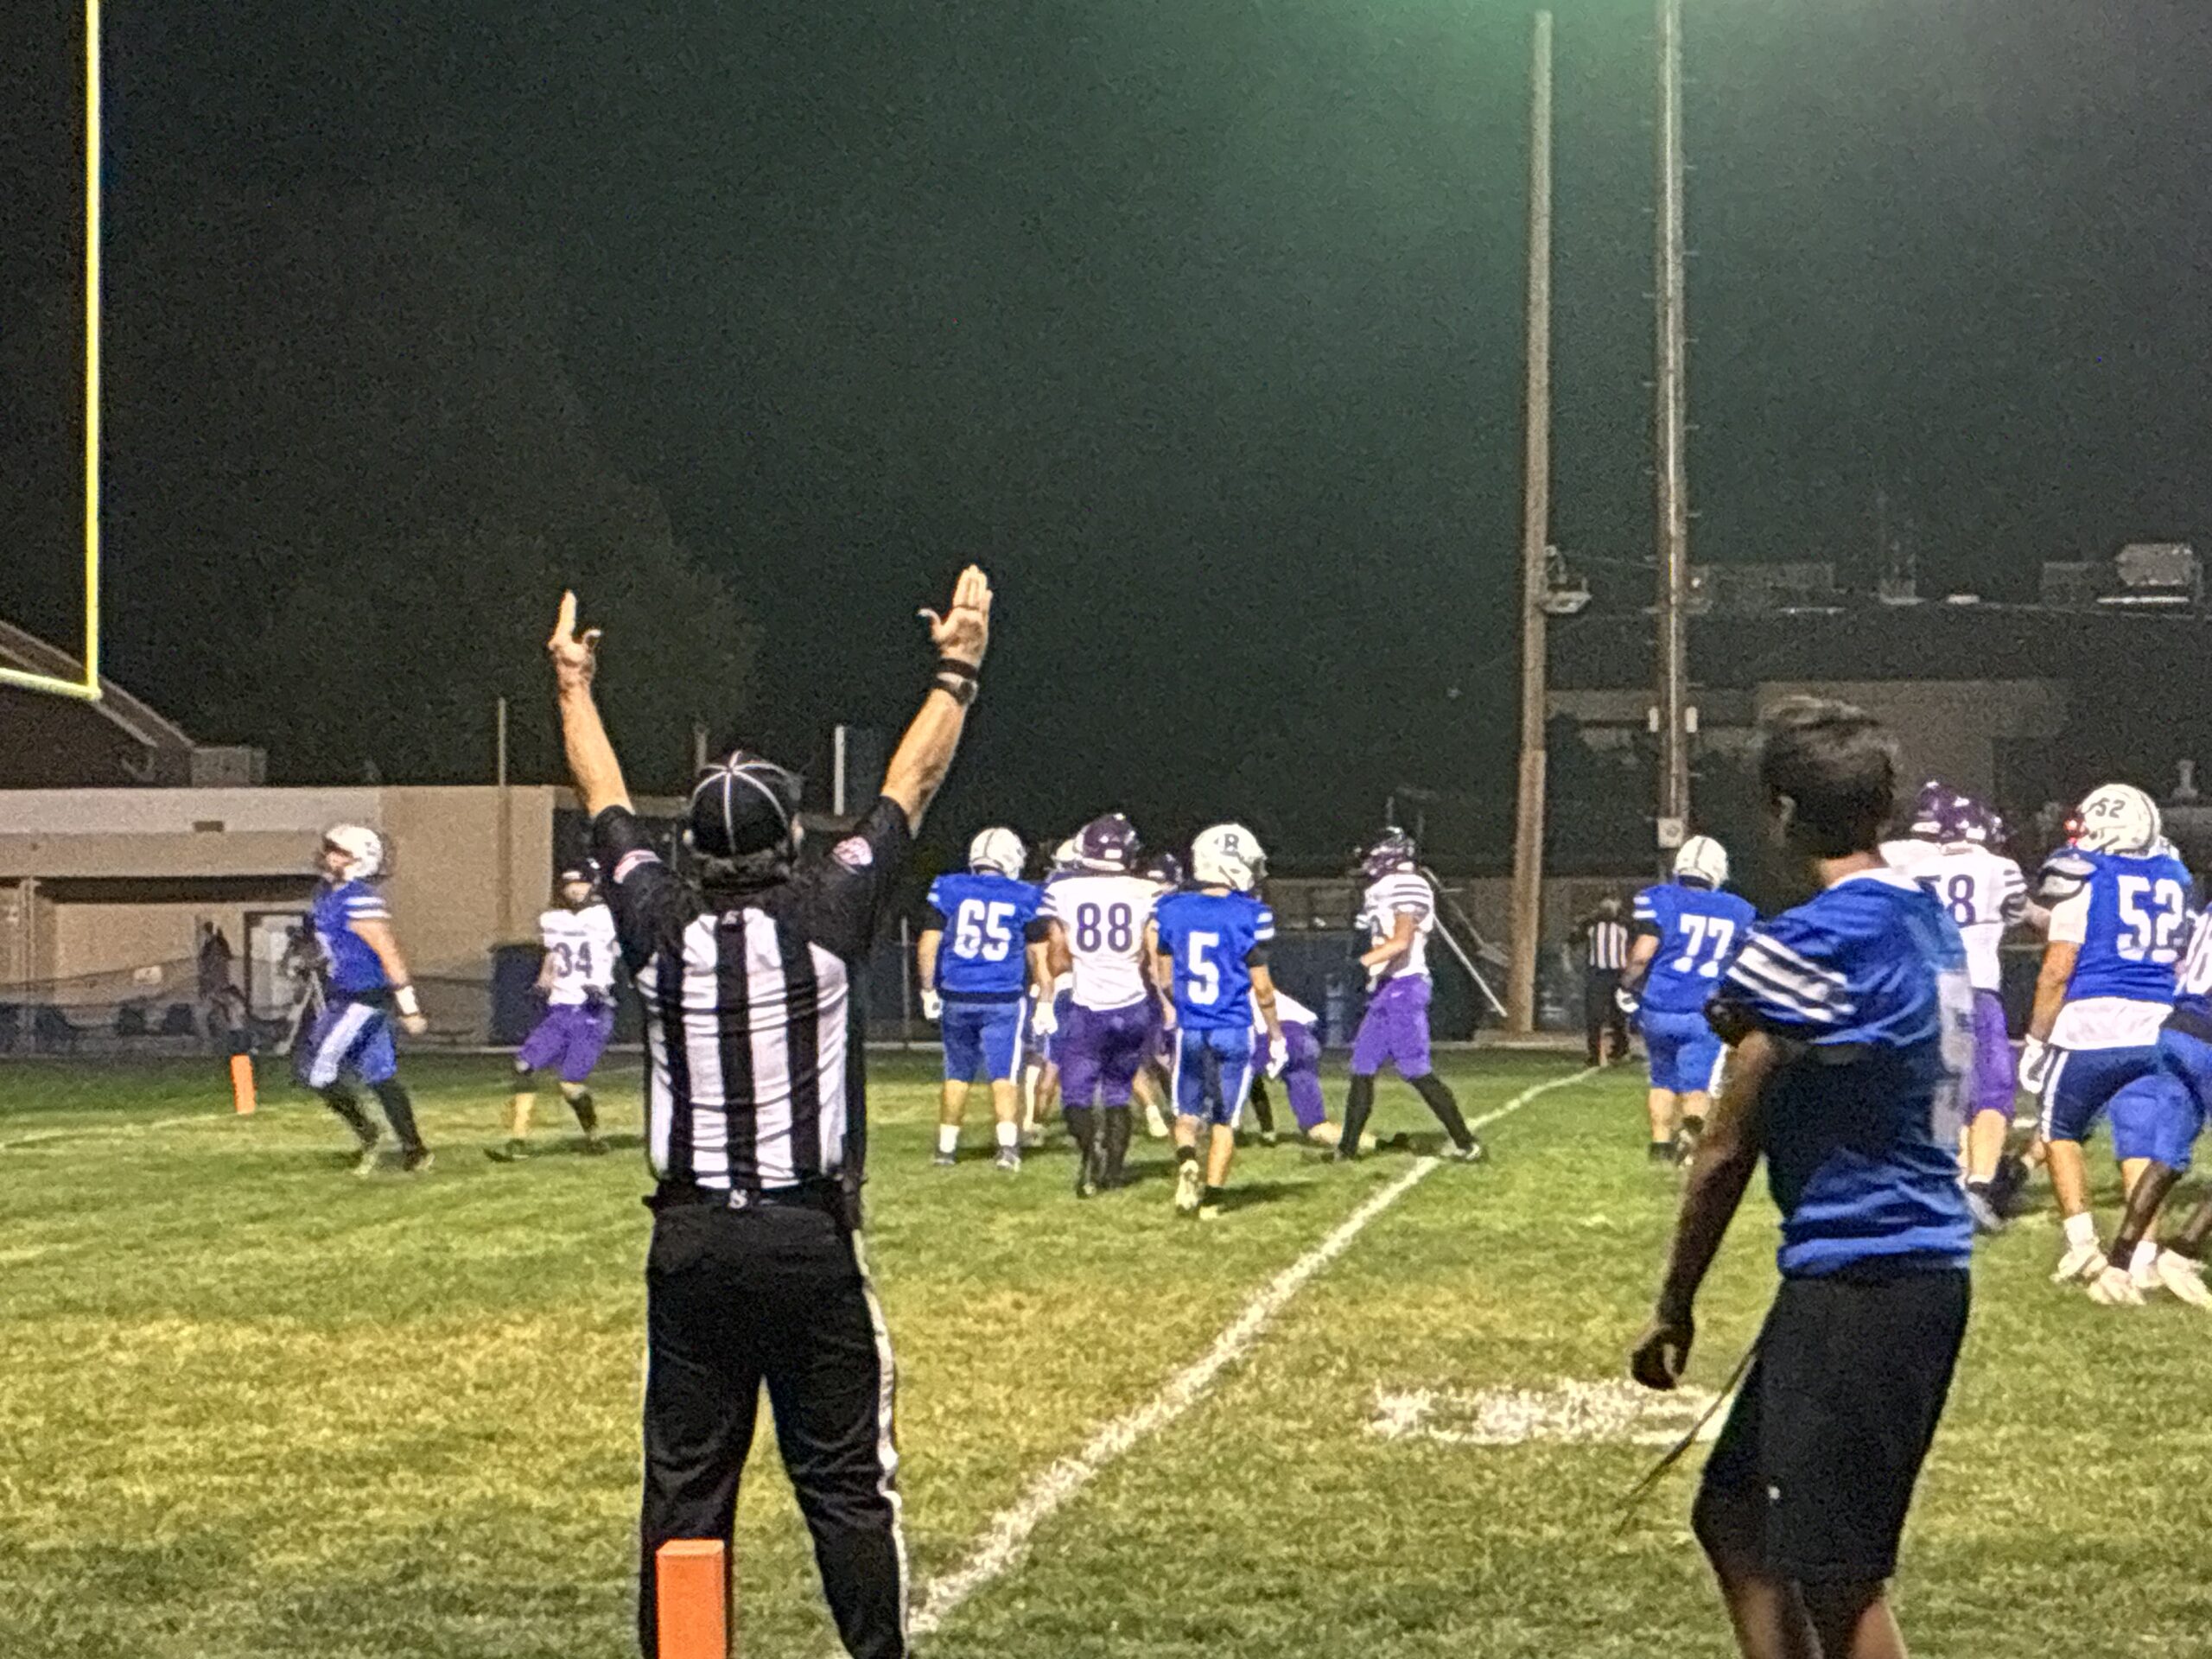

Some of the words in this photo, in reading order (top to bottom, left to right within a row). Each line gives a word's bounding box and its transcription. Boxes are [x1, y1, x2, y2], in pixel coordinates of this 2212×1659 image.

[954, 899, 1016, 962] 65
[1077, 902, 1133, 952] 88
[1672, 912, 1735, 978] 77
[2117, 874, 2183, 963] 52
[553, 941, 594, 979] 34
[1188, 931, 1219, 1005] 5
